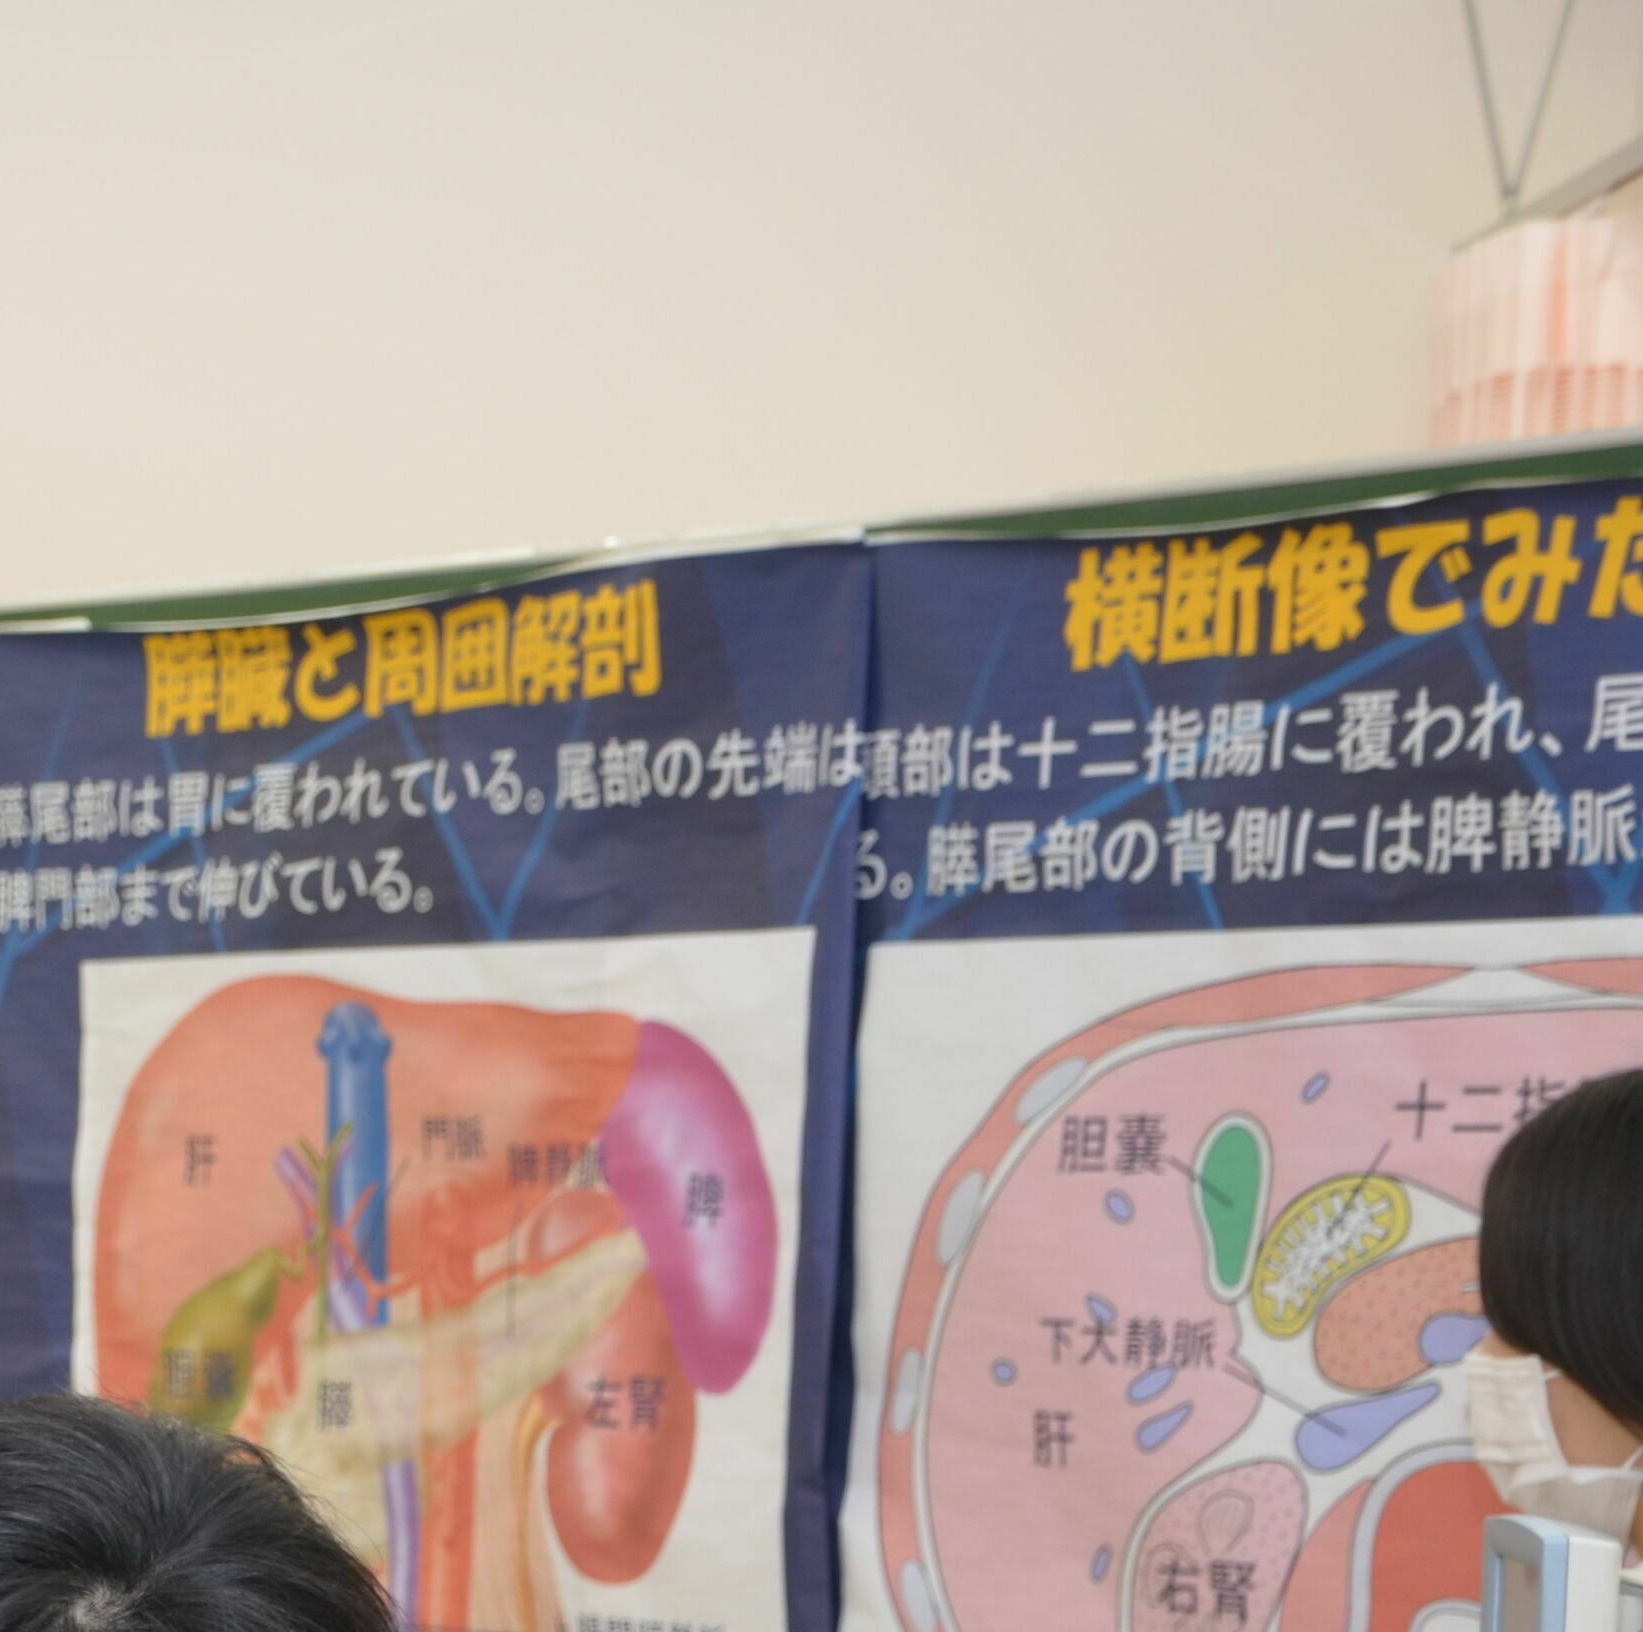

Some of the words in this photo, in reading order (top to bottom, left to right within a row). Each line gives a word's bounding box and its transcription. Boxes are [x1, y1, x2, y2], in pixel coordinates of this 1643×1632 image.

[144, 581, 662, 738] 膵臓と周囲解剖
[1038, 1315, 1219, 1373] 下大静脈
[584, 1375, 666, 1432] 左腎
[1030, 1409, 1075, 1469] 肝
[1155, 1558, 1258, 1623] 右腎
